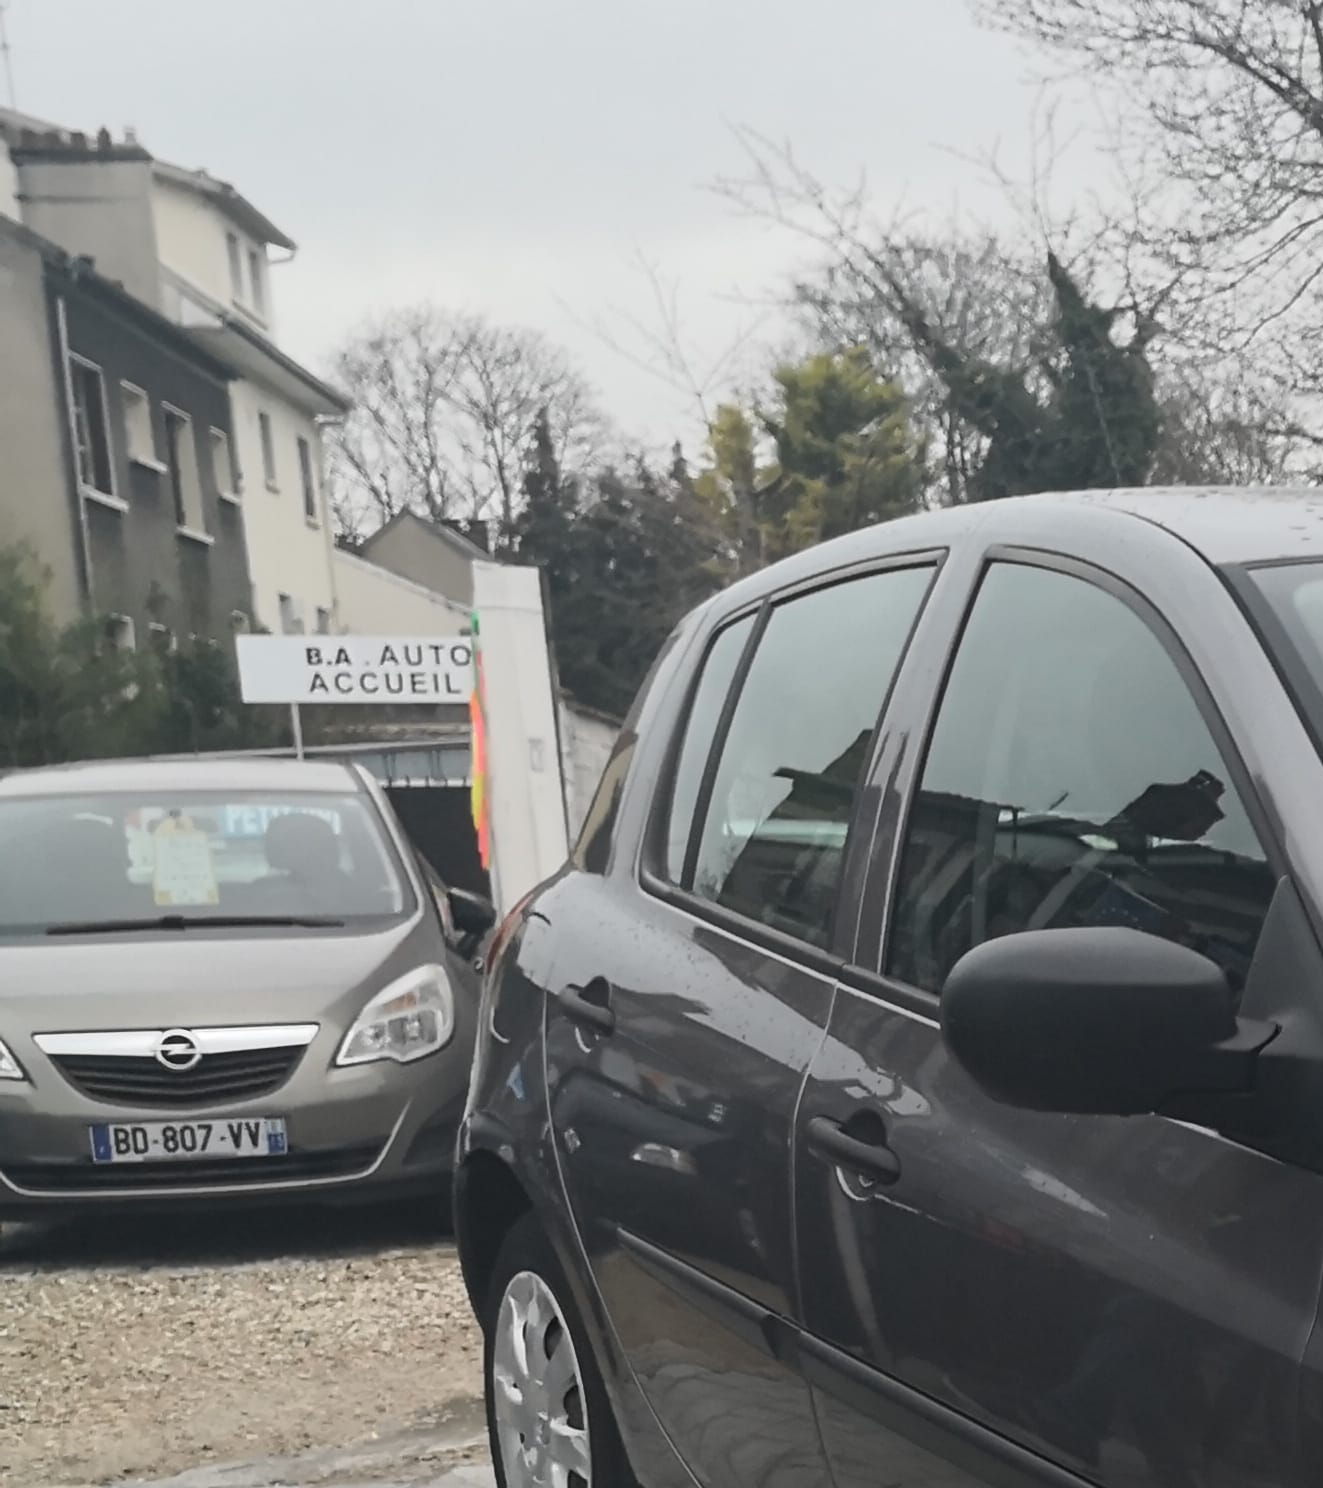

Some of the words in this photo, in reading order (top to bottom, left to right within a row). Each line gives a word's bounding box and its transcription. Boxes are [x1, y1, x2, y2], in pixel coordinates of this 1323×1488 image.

[379, 644, 472, 667] AUTO
[309, 672, 463, 694] ACCUEIL
[113, 1121, 261, 1155] BD-807-VV
